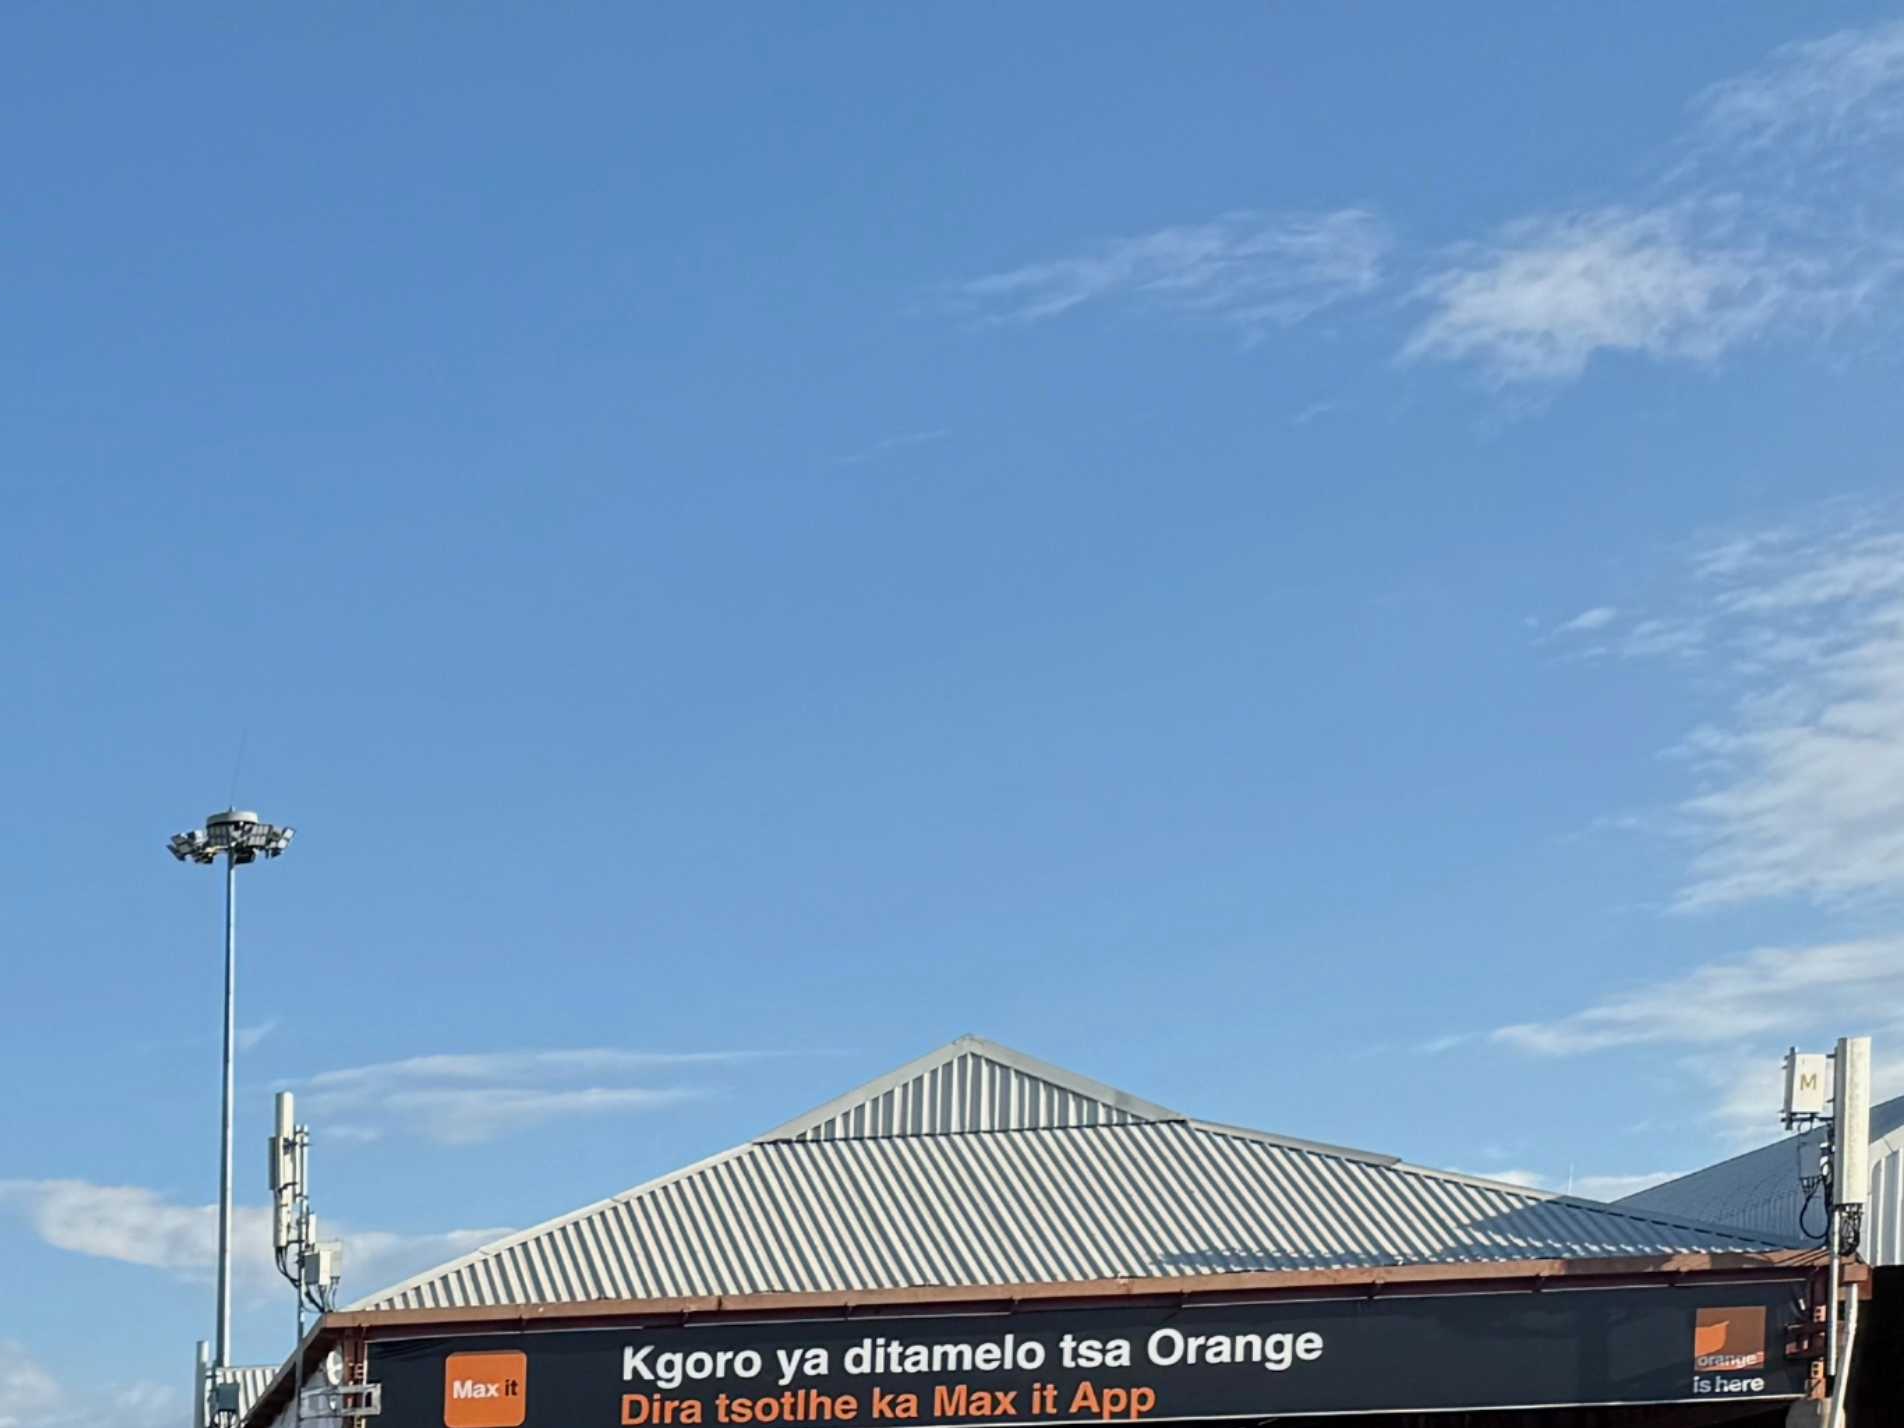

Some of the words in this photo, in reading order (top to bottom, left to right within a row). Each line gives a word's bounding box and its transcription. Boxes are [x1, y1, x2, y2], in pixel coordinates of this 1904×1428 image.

[622, 1345, 762, 1389] Kgoro
[776, 1347, 829, 1386] ya
[843, 1334, 1046, 1375] ditamelo
[1060, 1333, 1131, 1369] tsa
[1147, 1328, 1324, 1372] Orange
[452, 1380, 499, 1400] Max
[504, 1379, 519, 1397] it
[1693, 1376, 1712, 1393] is
[1714, 1375, 1765, 1393] here
[620, 1392, 704, 1426] Dira
[715, 1388, 858, 1424] tsotlhe
[871, 1386, 919, 1419] ka
[933, 1382, 1018, 1418] Max
[1031, 1381, 1057, 1415] it
[1069, 1380, 1157, 1422] App
